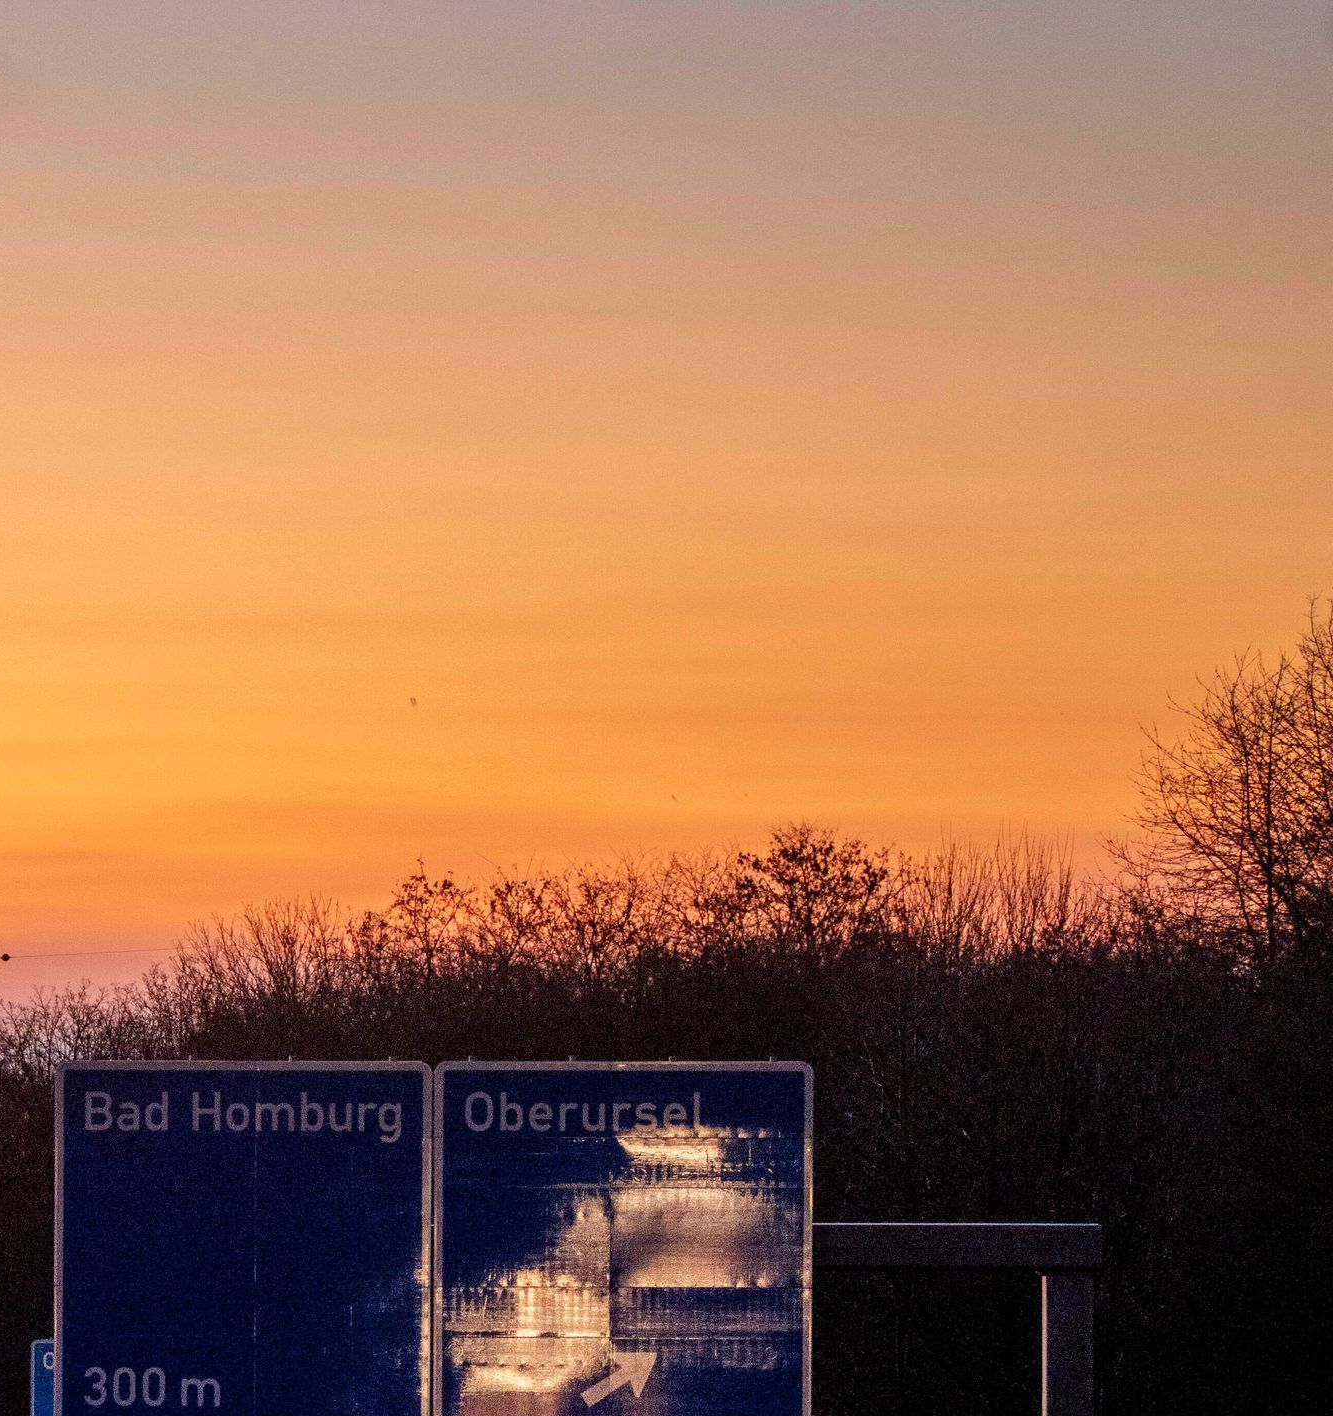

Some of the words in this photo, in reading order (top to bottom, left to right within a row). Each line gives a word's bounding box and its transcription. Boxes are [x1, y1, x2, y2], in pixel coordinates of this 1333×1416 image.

[84, 1091, 169, 1132] Bad
[191, 1091, 402, 1143] Homburg
[464, 1091, 702, 1134] Oberursel
[84, 1366, 166, 1407] 300
[180, 1377, 221, 1407] m
